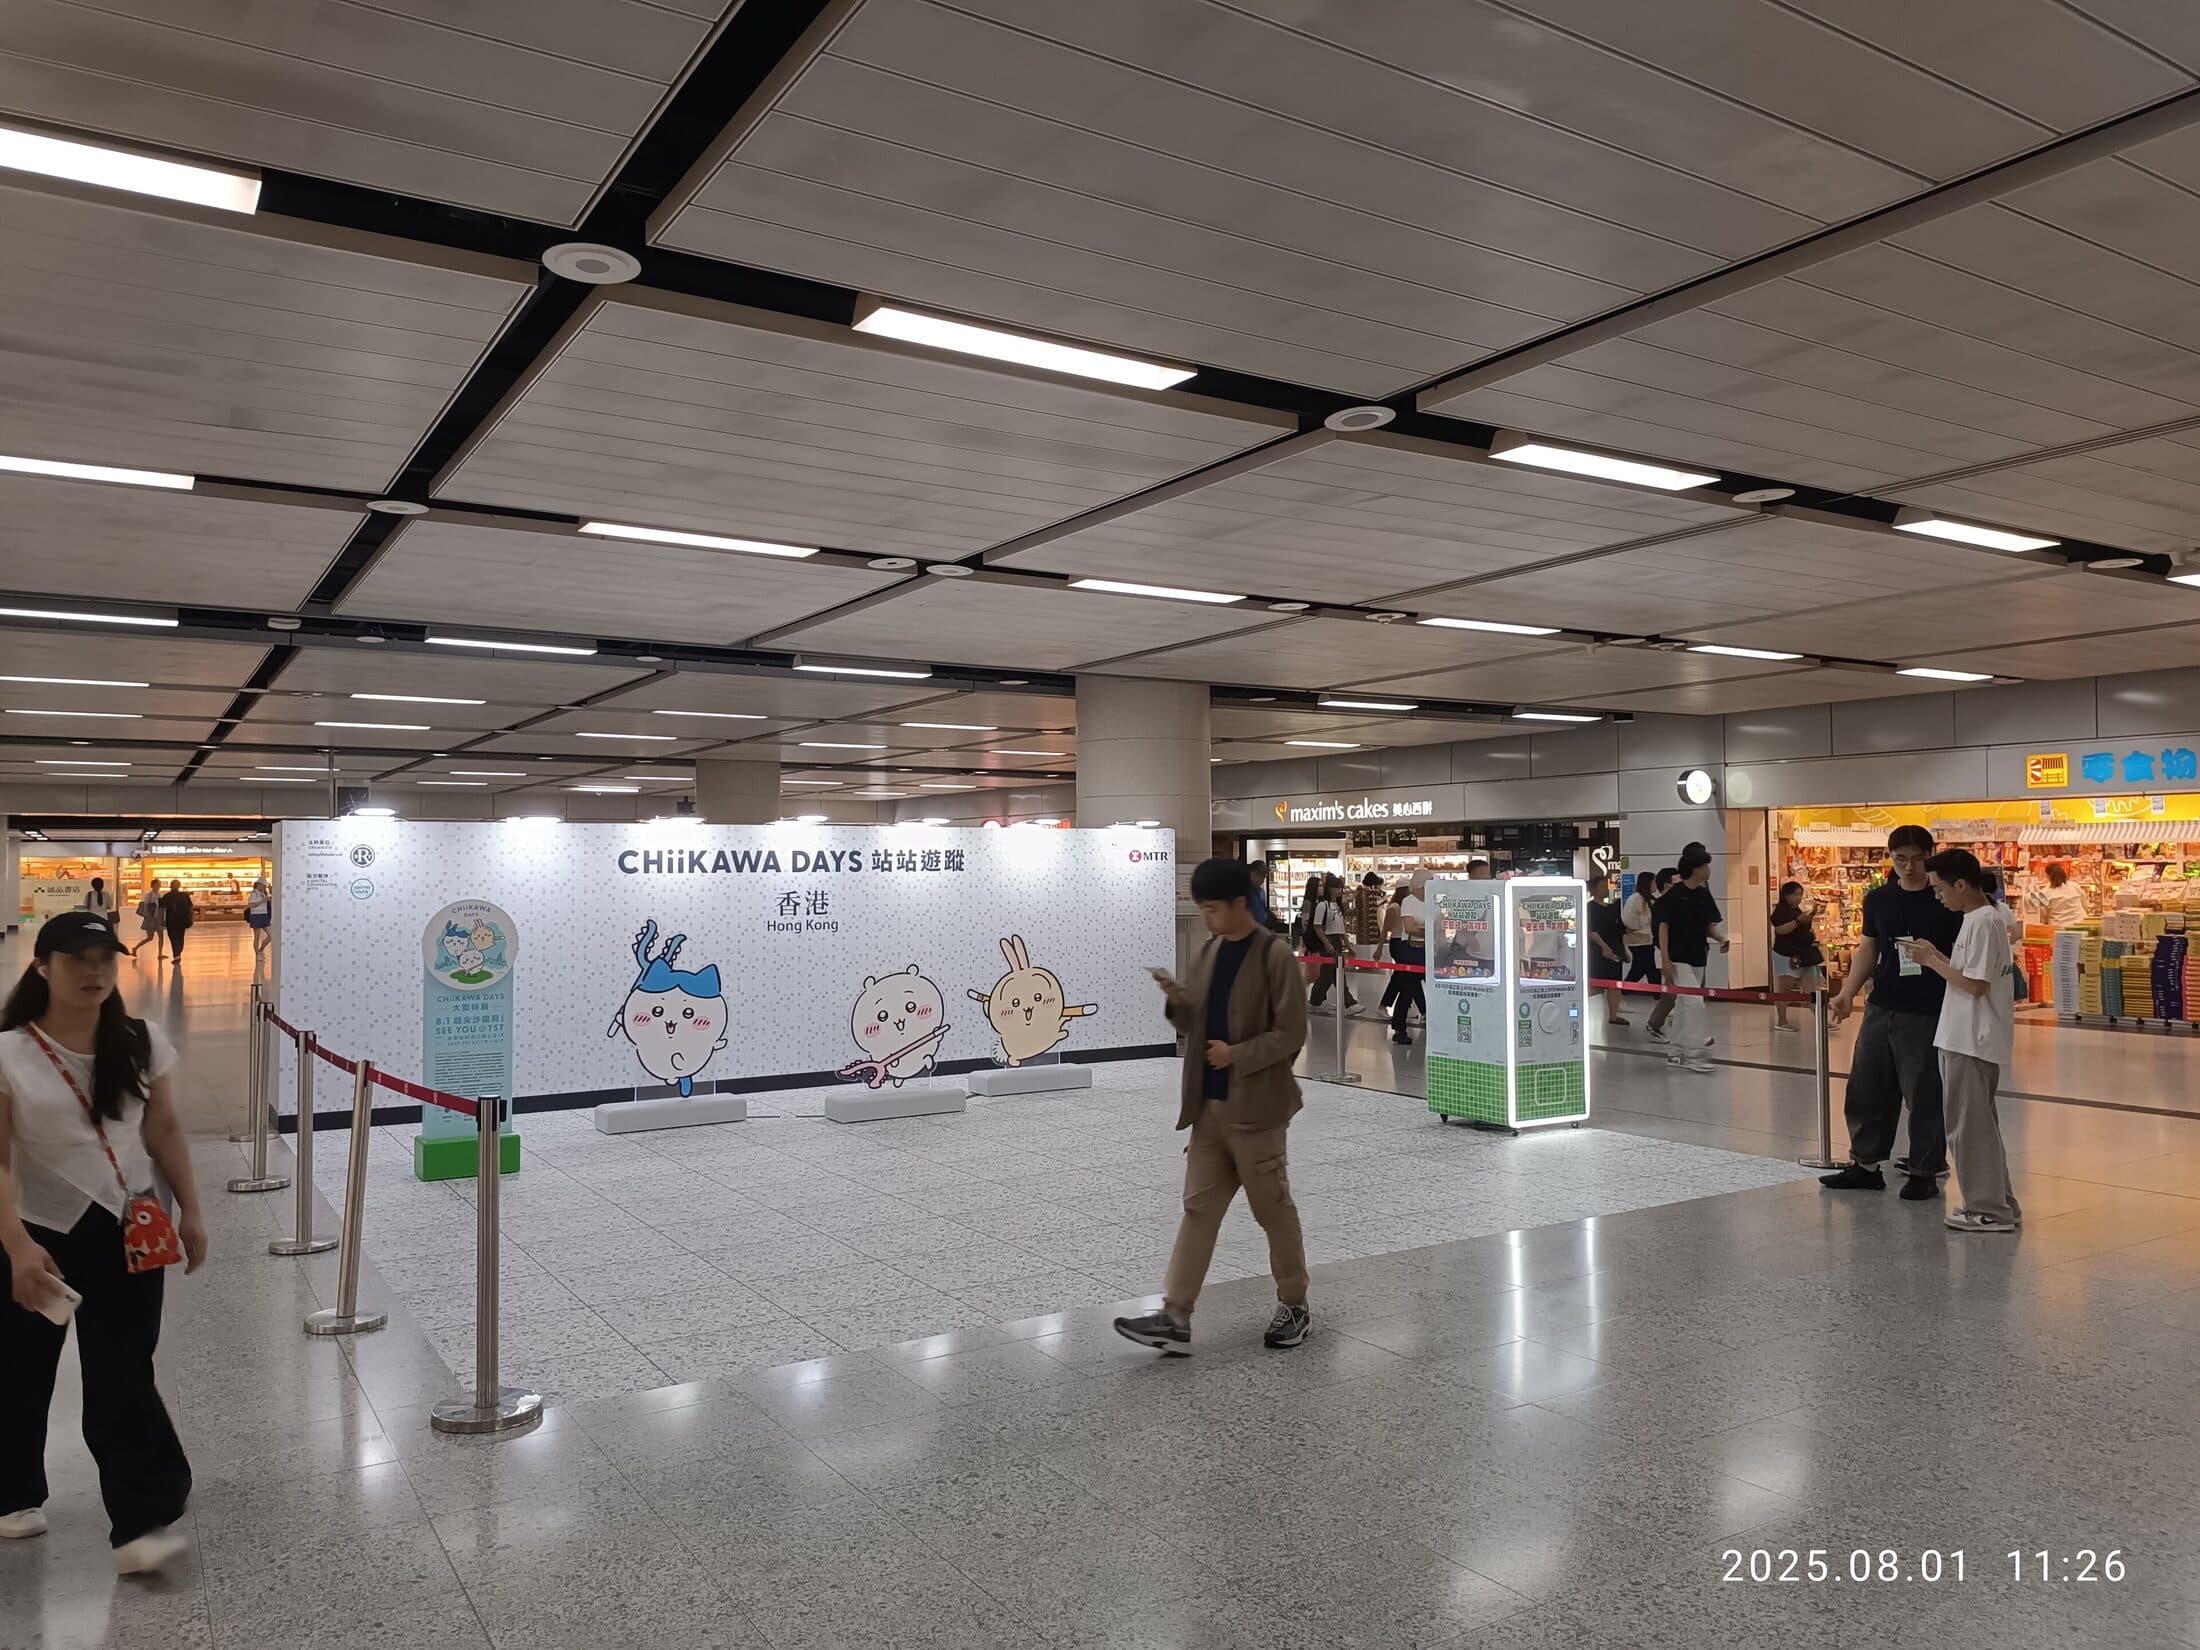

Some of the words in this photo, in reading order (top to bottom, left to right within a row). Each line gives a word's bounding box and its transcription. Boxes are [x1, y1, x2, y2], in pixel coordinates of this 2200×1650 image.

[1290, 800, 1344, 822] maxim's
[1347, 797, 1389, 820] cakes
[791, 849, 863, 873] DAYS
[871, 848, 966, 873] 站站遊蹤
[1143, 851, 1169, 862] MTR
[775, 890, 830, 918] 香港
[767, 920, 802, 933] Hong
[806, 919, 839, 933] Kong
[483, 993, 505, 1001] DAYS
[435, 1026, 453, 1035] SEE
[456, 1025, 477, 1034] YOU
